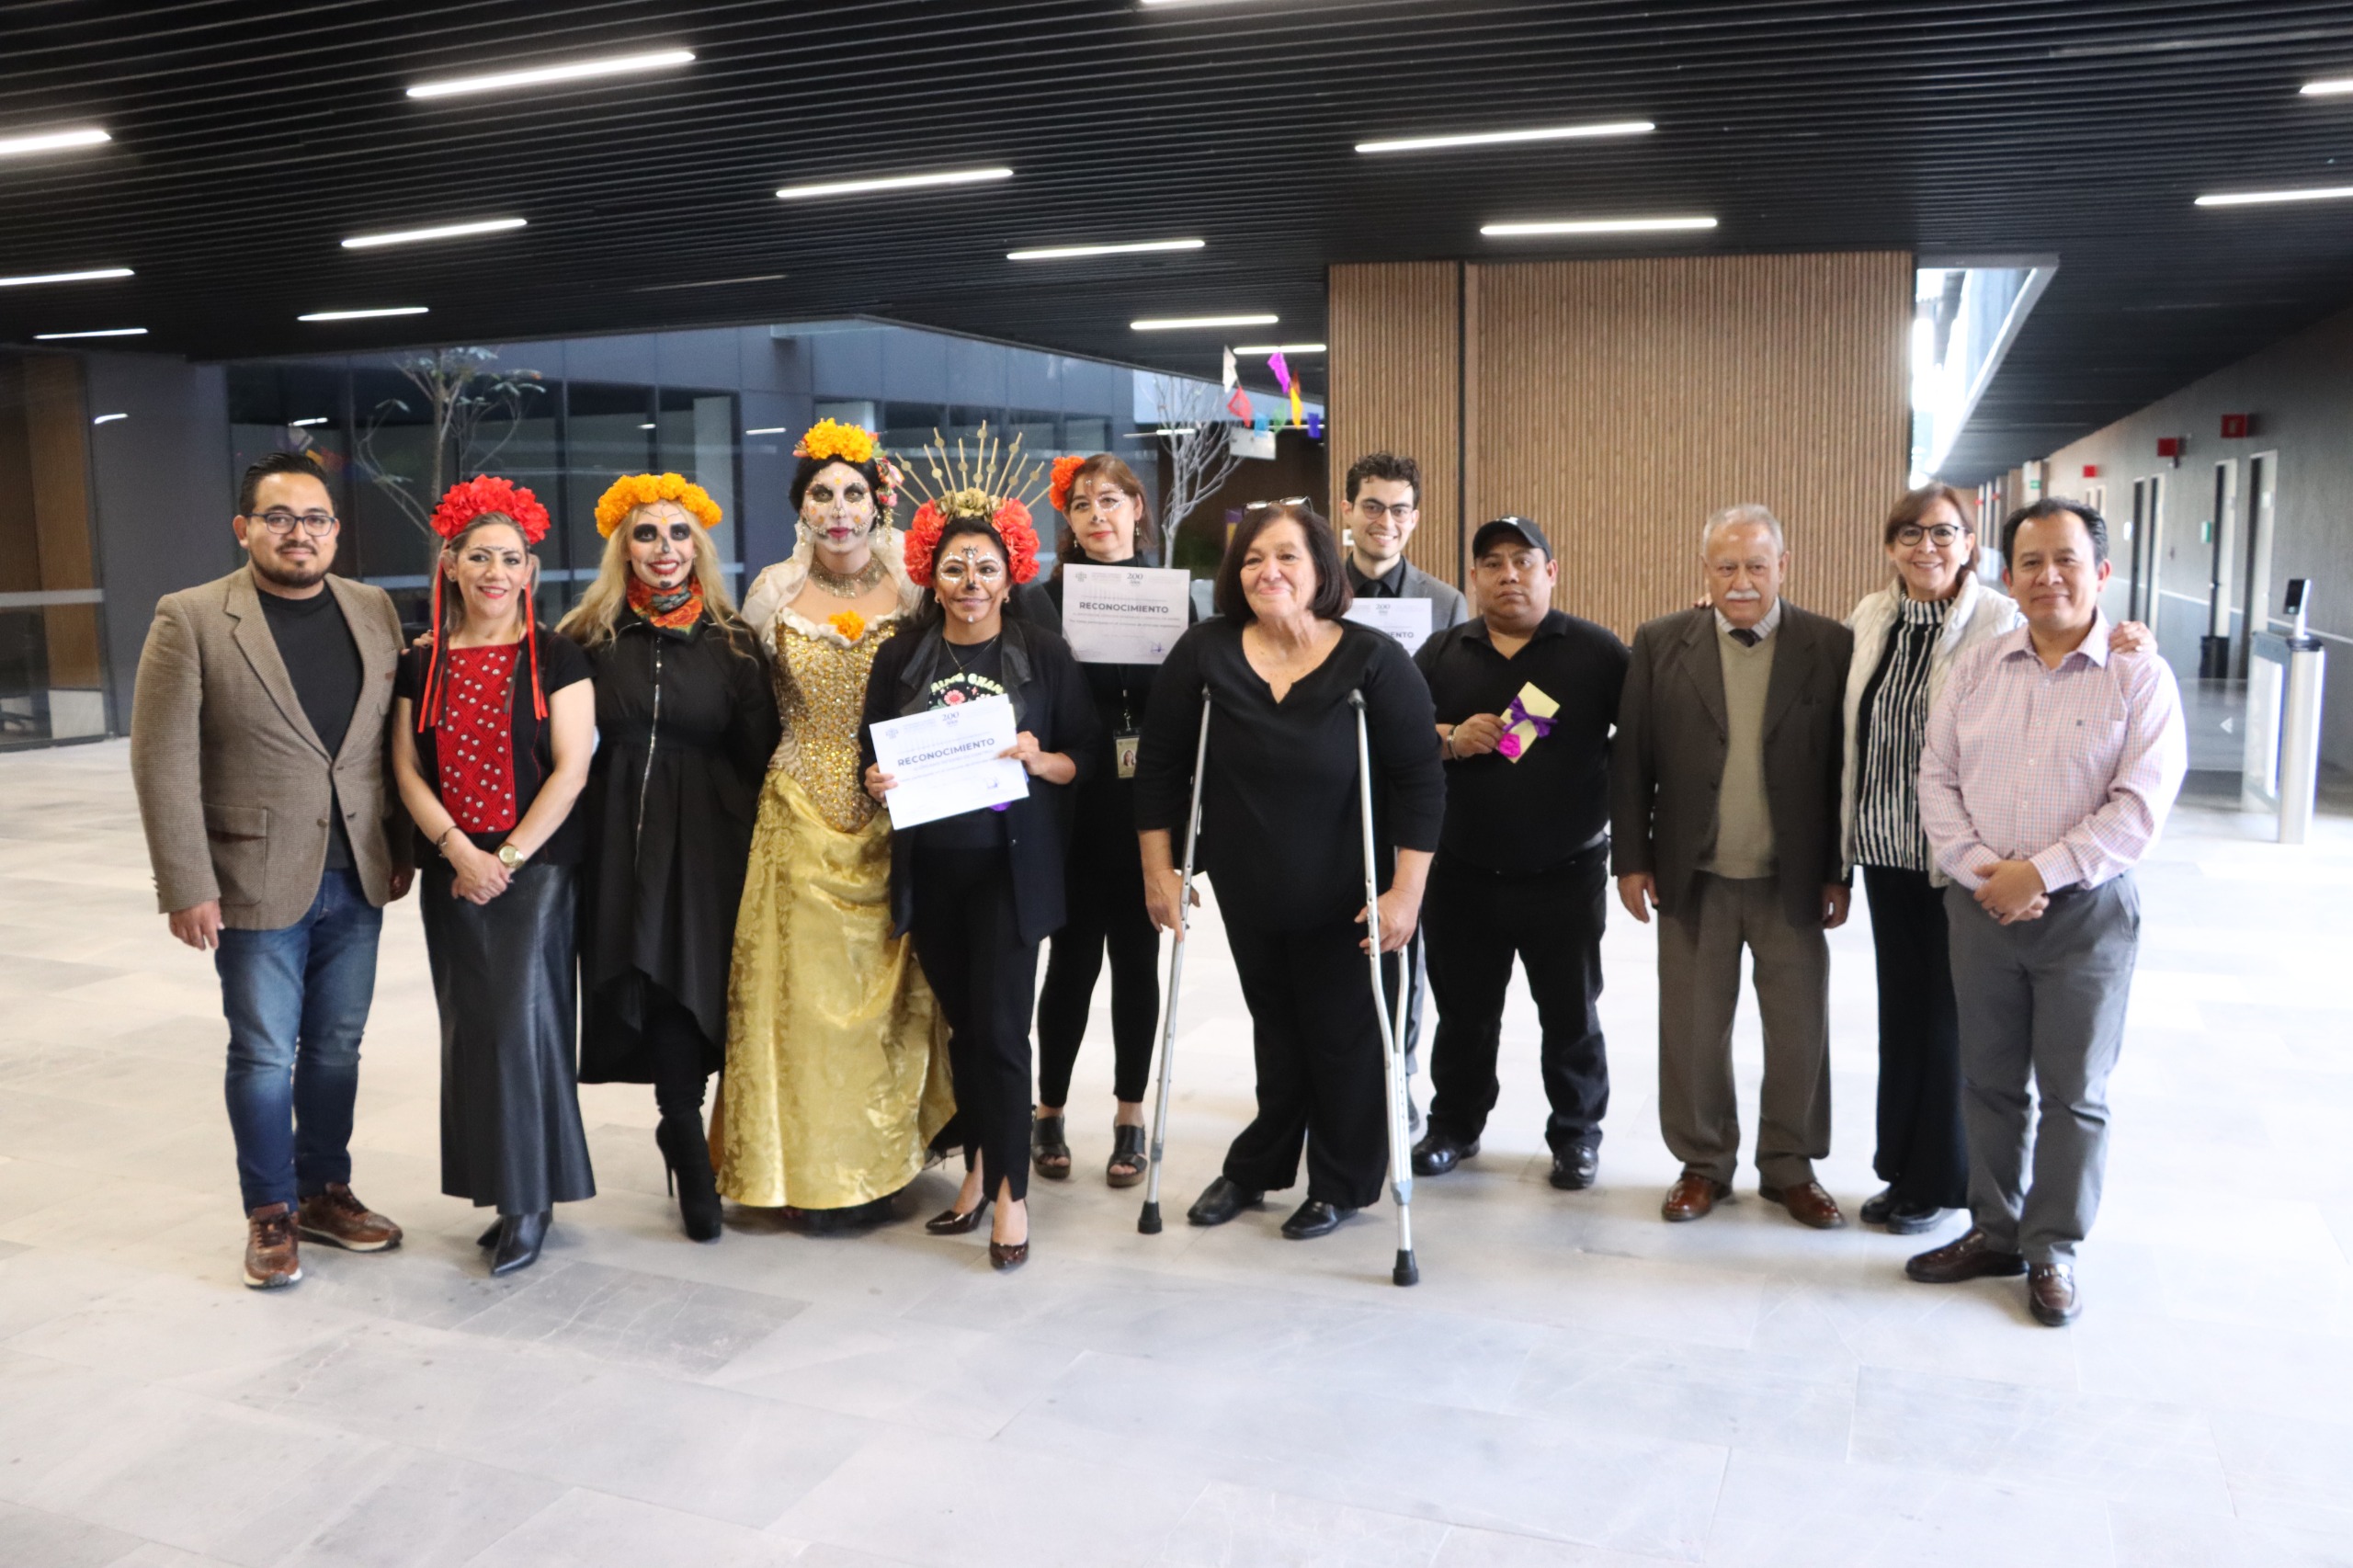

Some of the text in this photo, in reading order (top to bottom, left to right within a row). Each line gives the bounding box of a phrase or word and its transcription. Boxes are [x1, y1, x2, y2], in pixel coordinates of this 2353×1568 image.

[1079, 602, 1169, 613] RECONOCIMIENTO
[942, 711, 960, 722] 200
[898, 738, 995, 767] RECONOCIMIENTO
